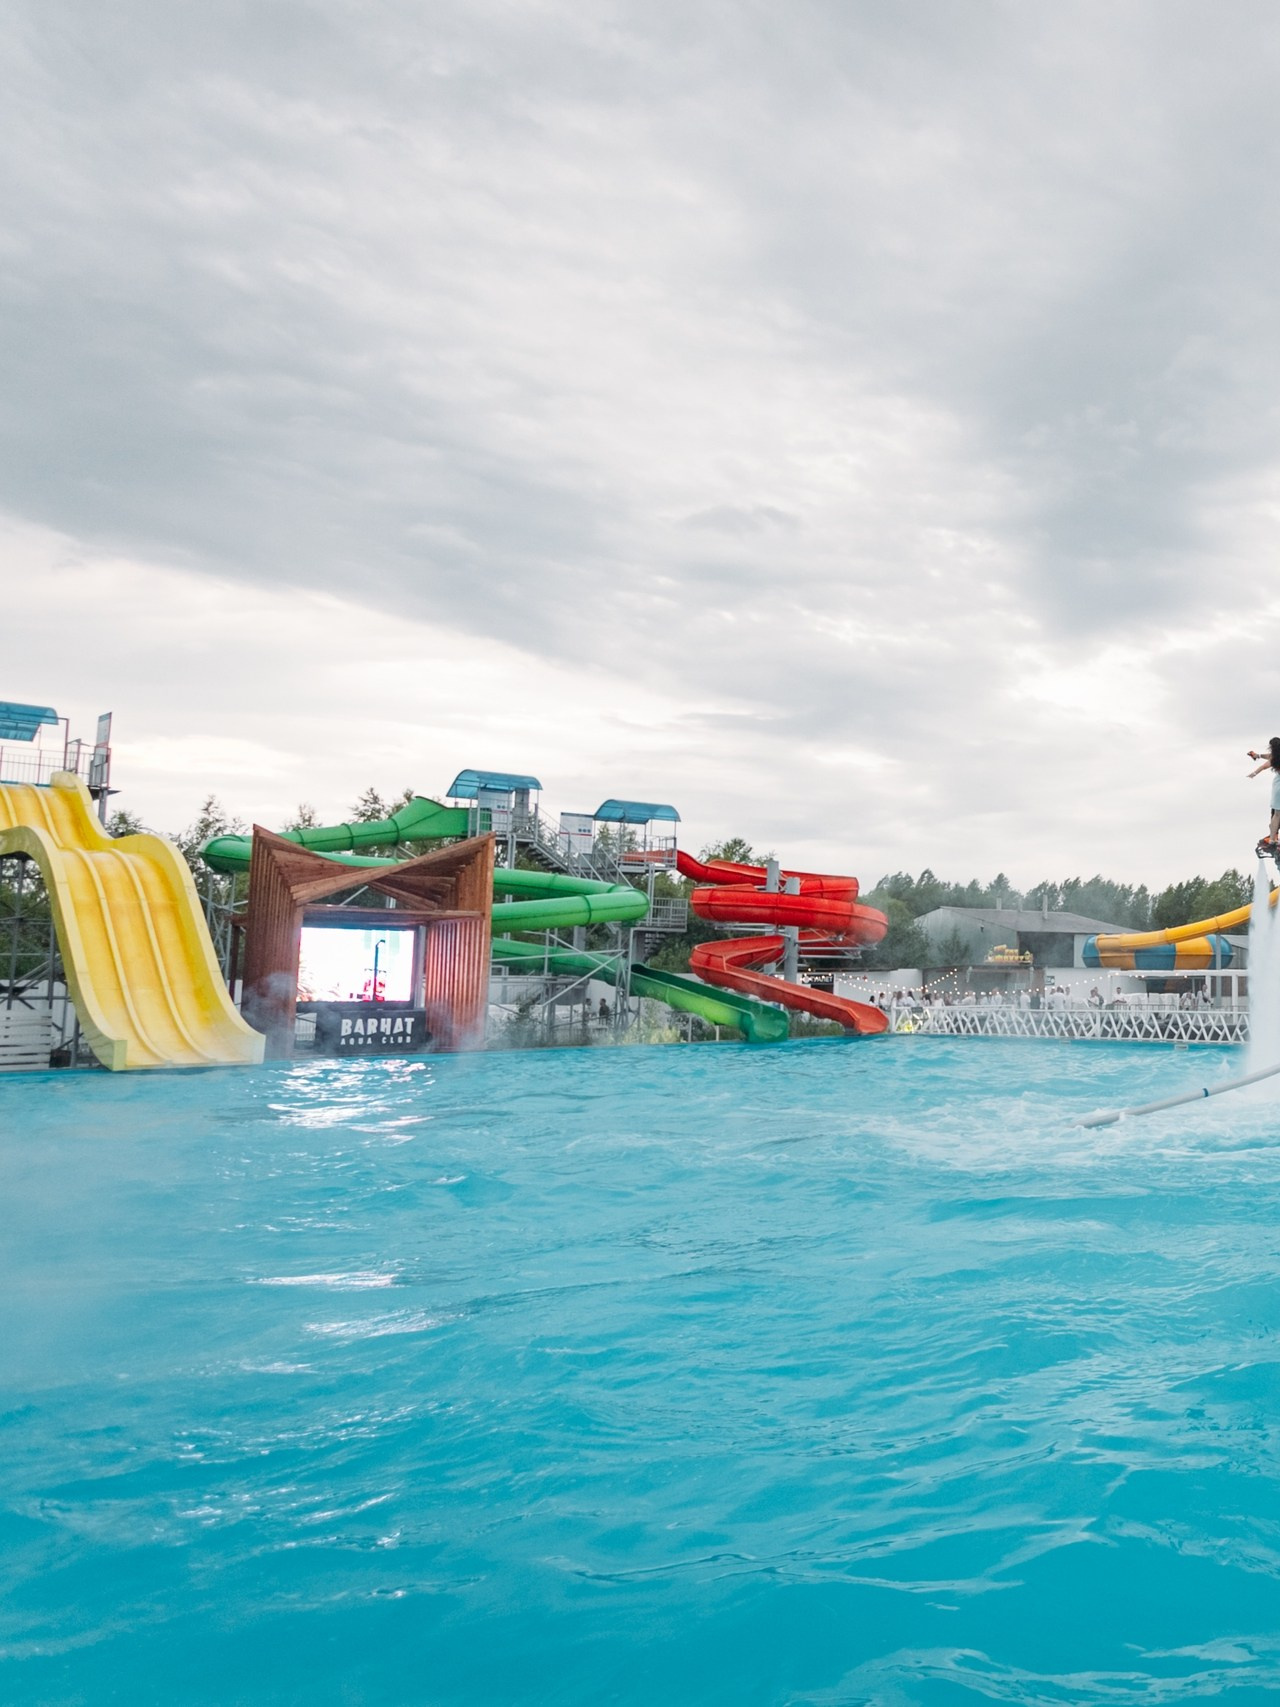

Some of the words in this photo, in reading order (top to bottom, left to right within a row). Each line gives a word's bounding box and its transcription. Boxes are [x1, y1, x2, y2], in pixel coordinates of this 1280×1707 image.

[341, 1018, 414, 1036] BARHAT
[340, 1037, 373, 1045] AQUA
[381, 1036, 412, 1044] CLUB
